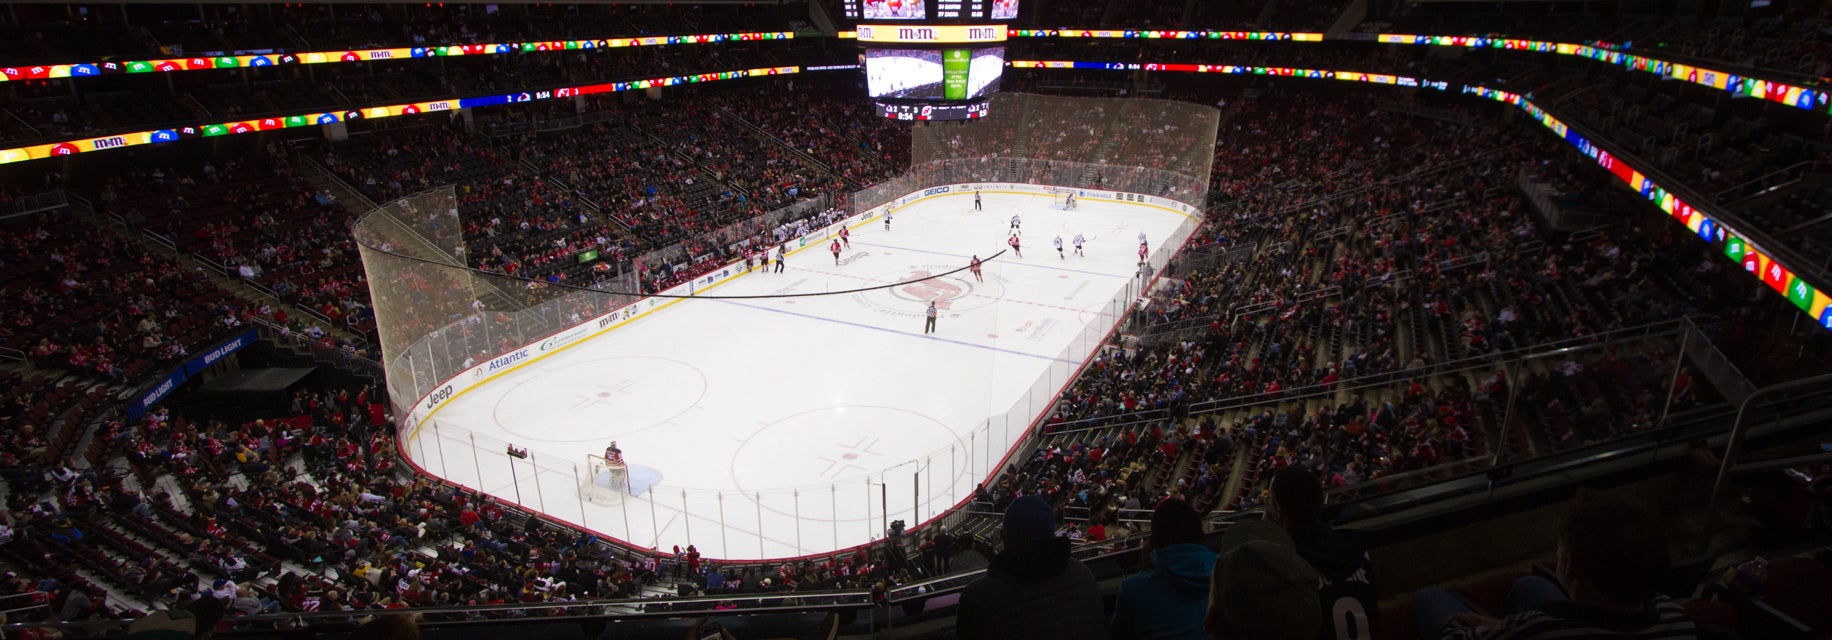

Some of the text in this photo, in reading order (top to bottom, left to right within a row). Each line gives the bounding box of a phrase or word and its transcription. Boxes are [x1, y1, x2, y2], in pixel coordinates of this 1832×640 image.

[924, 186, 949, 196] GEICO
[861, 211, 874, 221] Jeep
[204, 338, 242, 364] BUD LIGHT
[489, 349, 528, 371] Atlantic
[142, 379, 173, 407] BUD LIGHT
[427, 384, 453, 409] Jeep
